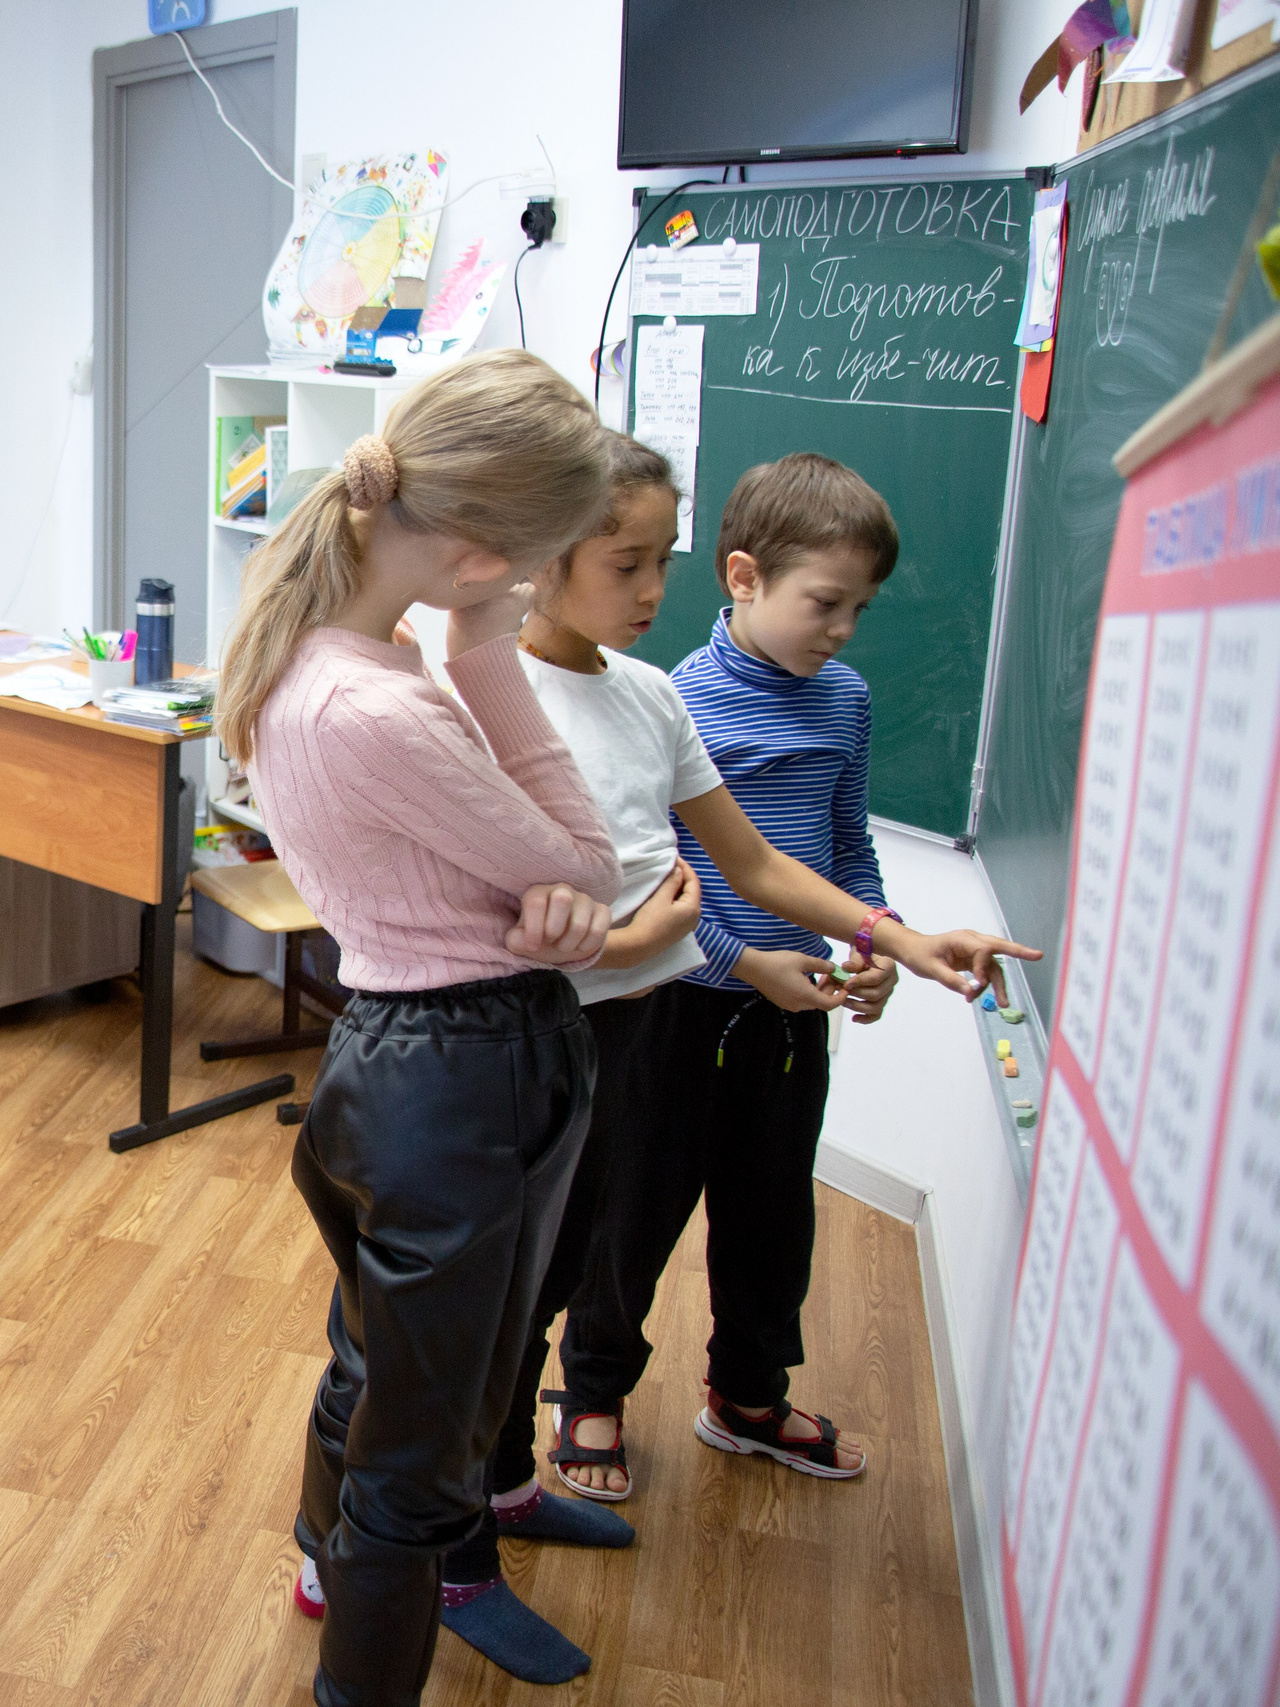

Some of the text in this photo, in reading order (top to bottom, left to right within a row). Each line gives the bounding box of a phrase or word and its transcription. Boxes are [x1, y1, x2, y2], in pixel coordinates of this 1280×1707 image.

[760, 148, 781, 156] SAMSUNG
[704, 184, 1020, 252] САМОПОДГОТОВКА
[768, 263, 789, 345] 1)
[799, 255, 1015, 341] Подготов-
[742, 345, 784, 376] ка
[796, 346, 822, 381] к
